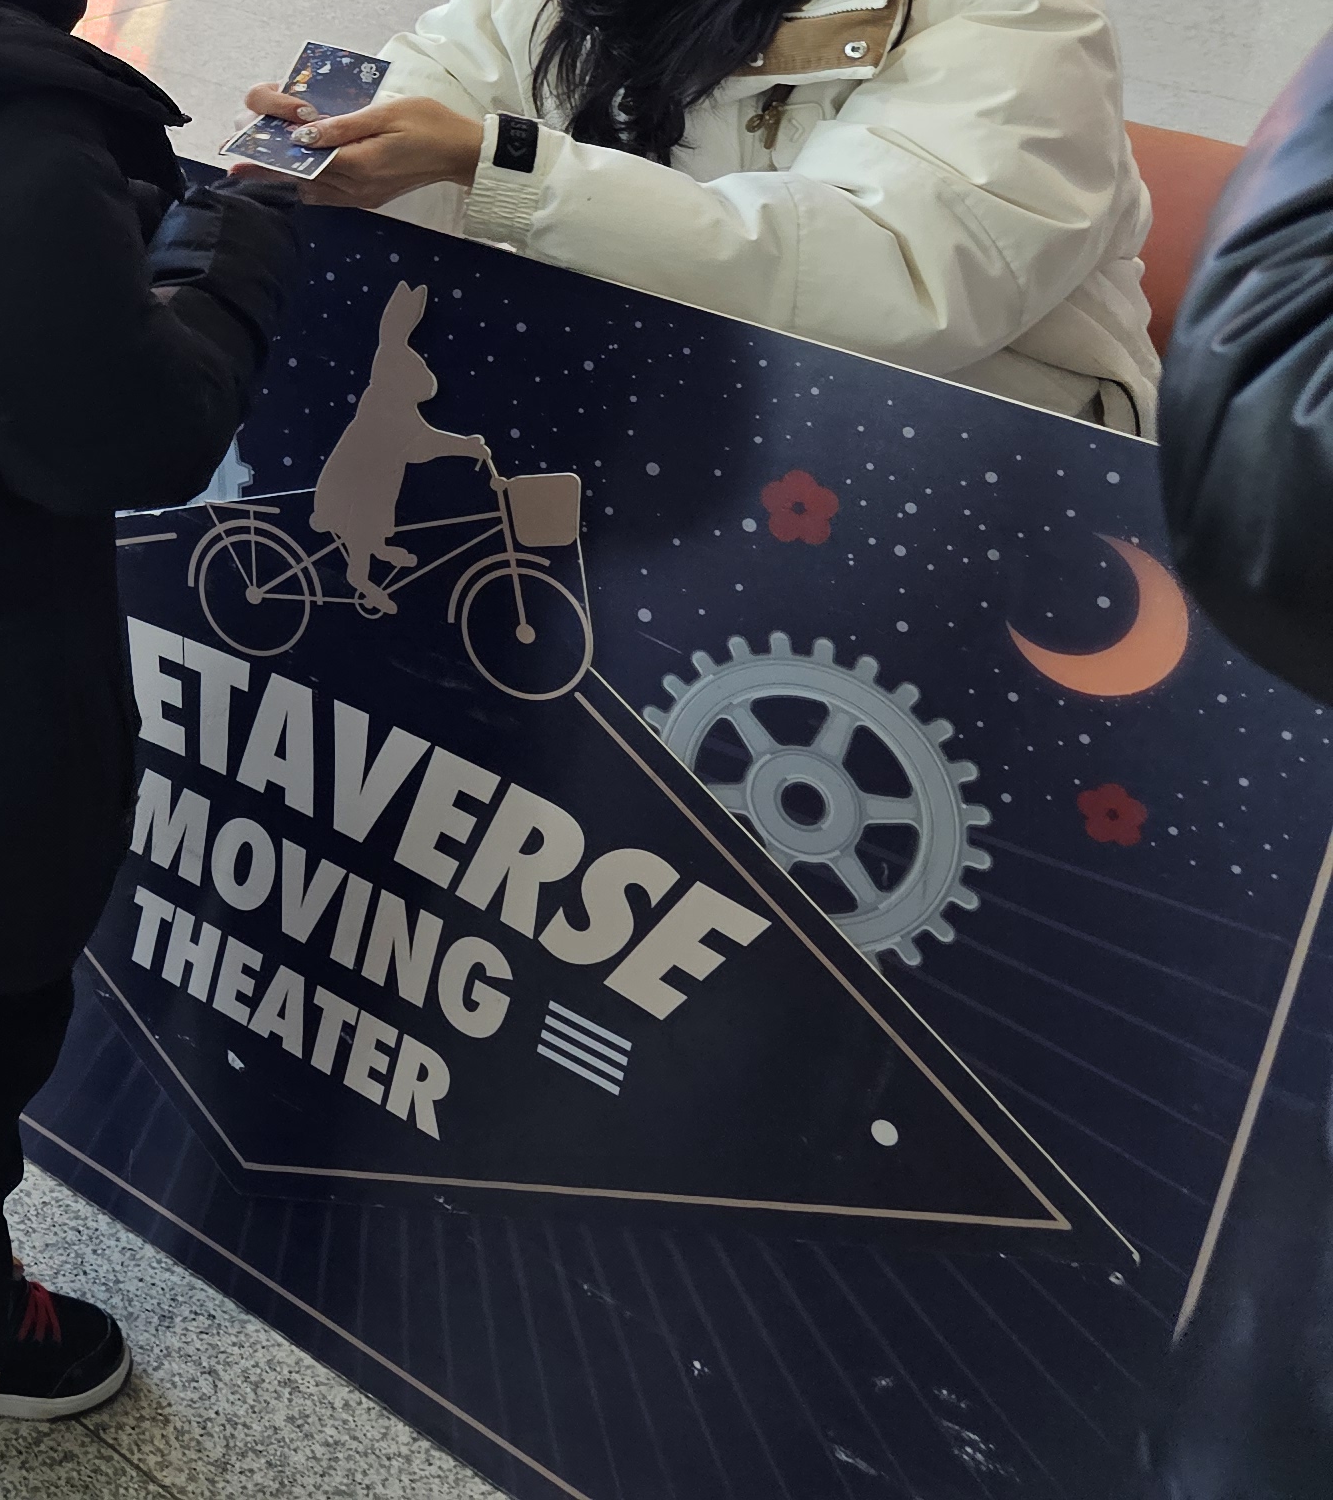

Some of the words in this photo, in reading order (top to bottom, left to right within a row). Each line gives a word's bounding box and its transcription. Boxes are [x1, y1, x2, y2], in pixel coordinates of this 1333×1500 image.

[127, 615, 773, 1021] ETAVERSE
[130, 767, 514, 1040] MOVING
[131, 884, 451, 1142] THEATER
